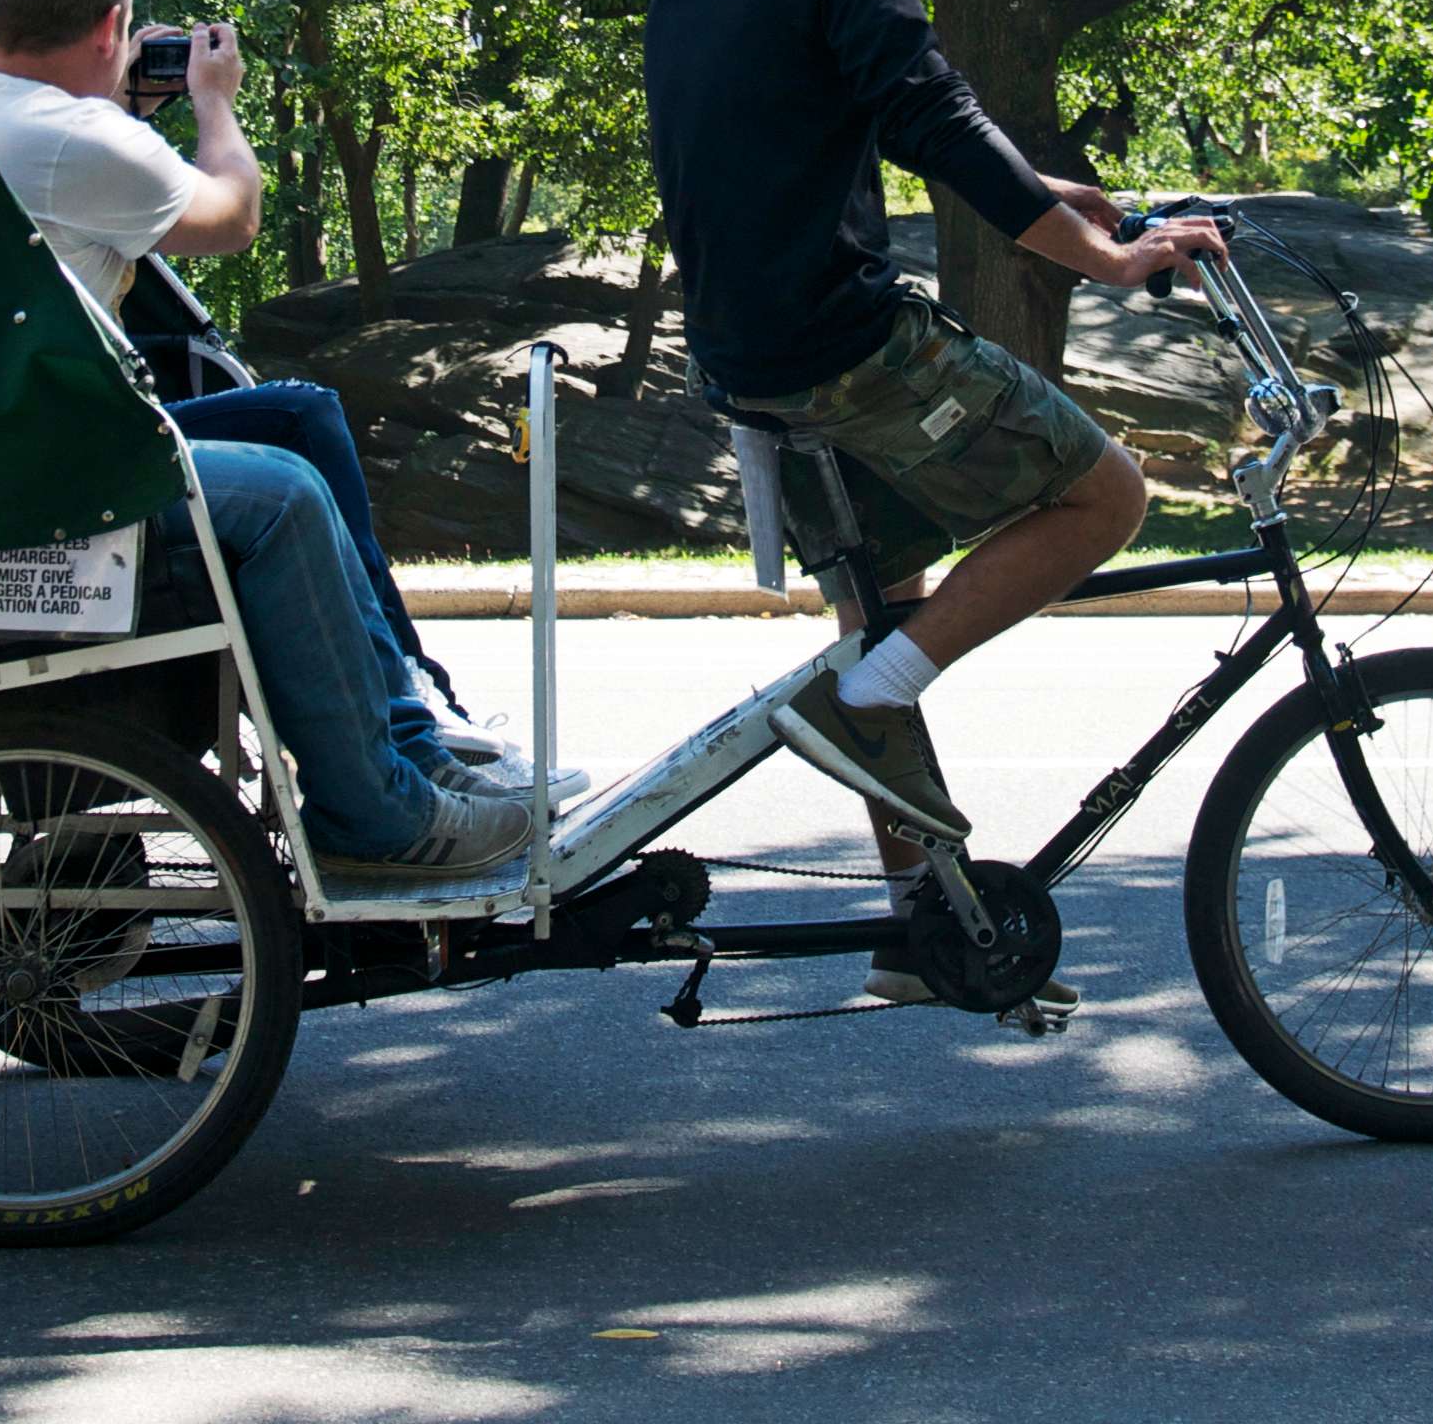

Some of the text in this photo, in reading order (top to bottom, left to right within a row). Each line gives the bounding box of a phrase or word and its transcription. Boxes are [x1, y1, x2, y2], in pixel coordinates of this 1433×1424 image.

[0, 550, 71, 565] CHARGED.
[41, 570, 74, 585] GIVE
[36, 585, 47, 598] A
[50, 586, 112, 601] PEDICAB
[41, 600, 84, 616] CARD.
[2, 1176, 150, 1224] MAXXIS
